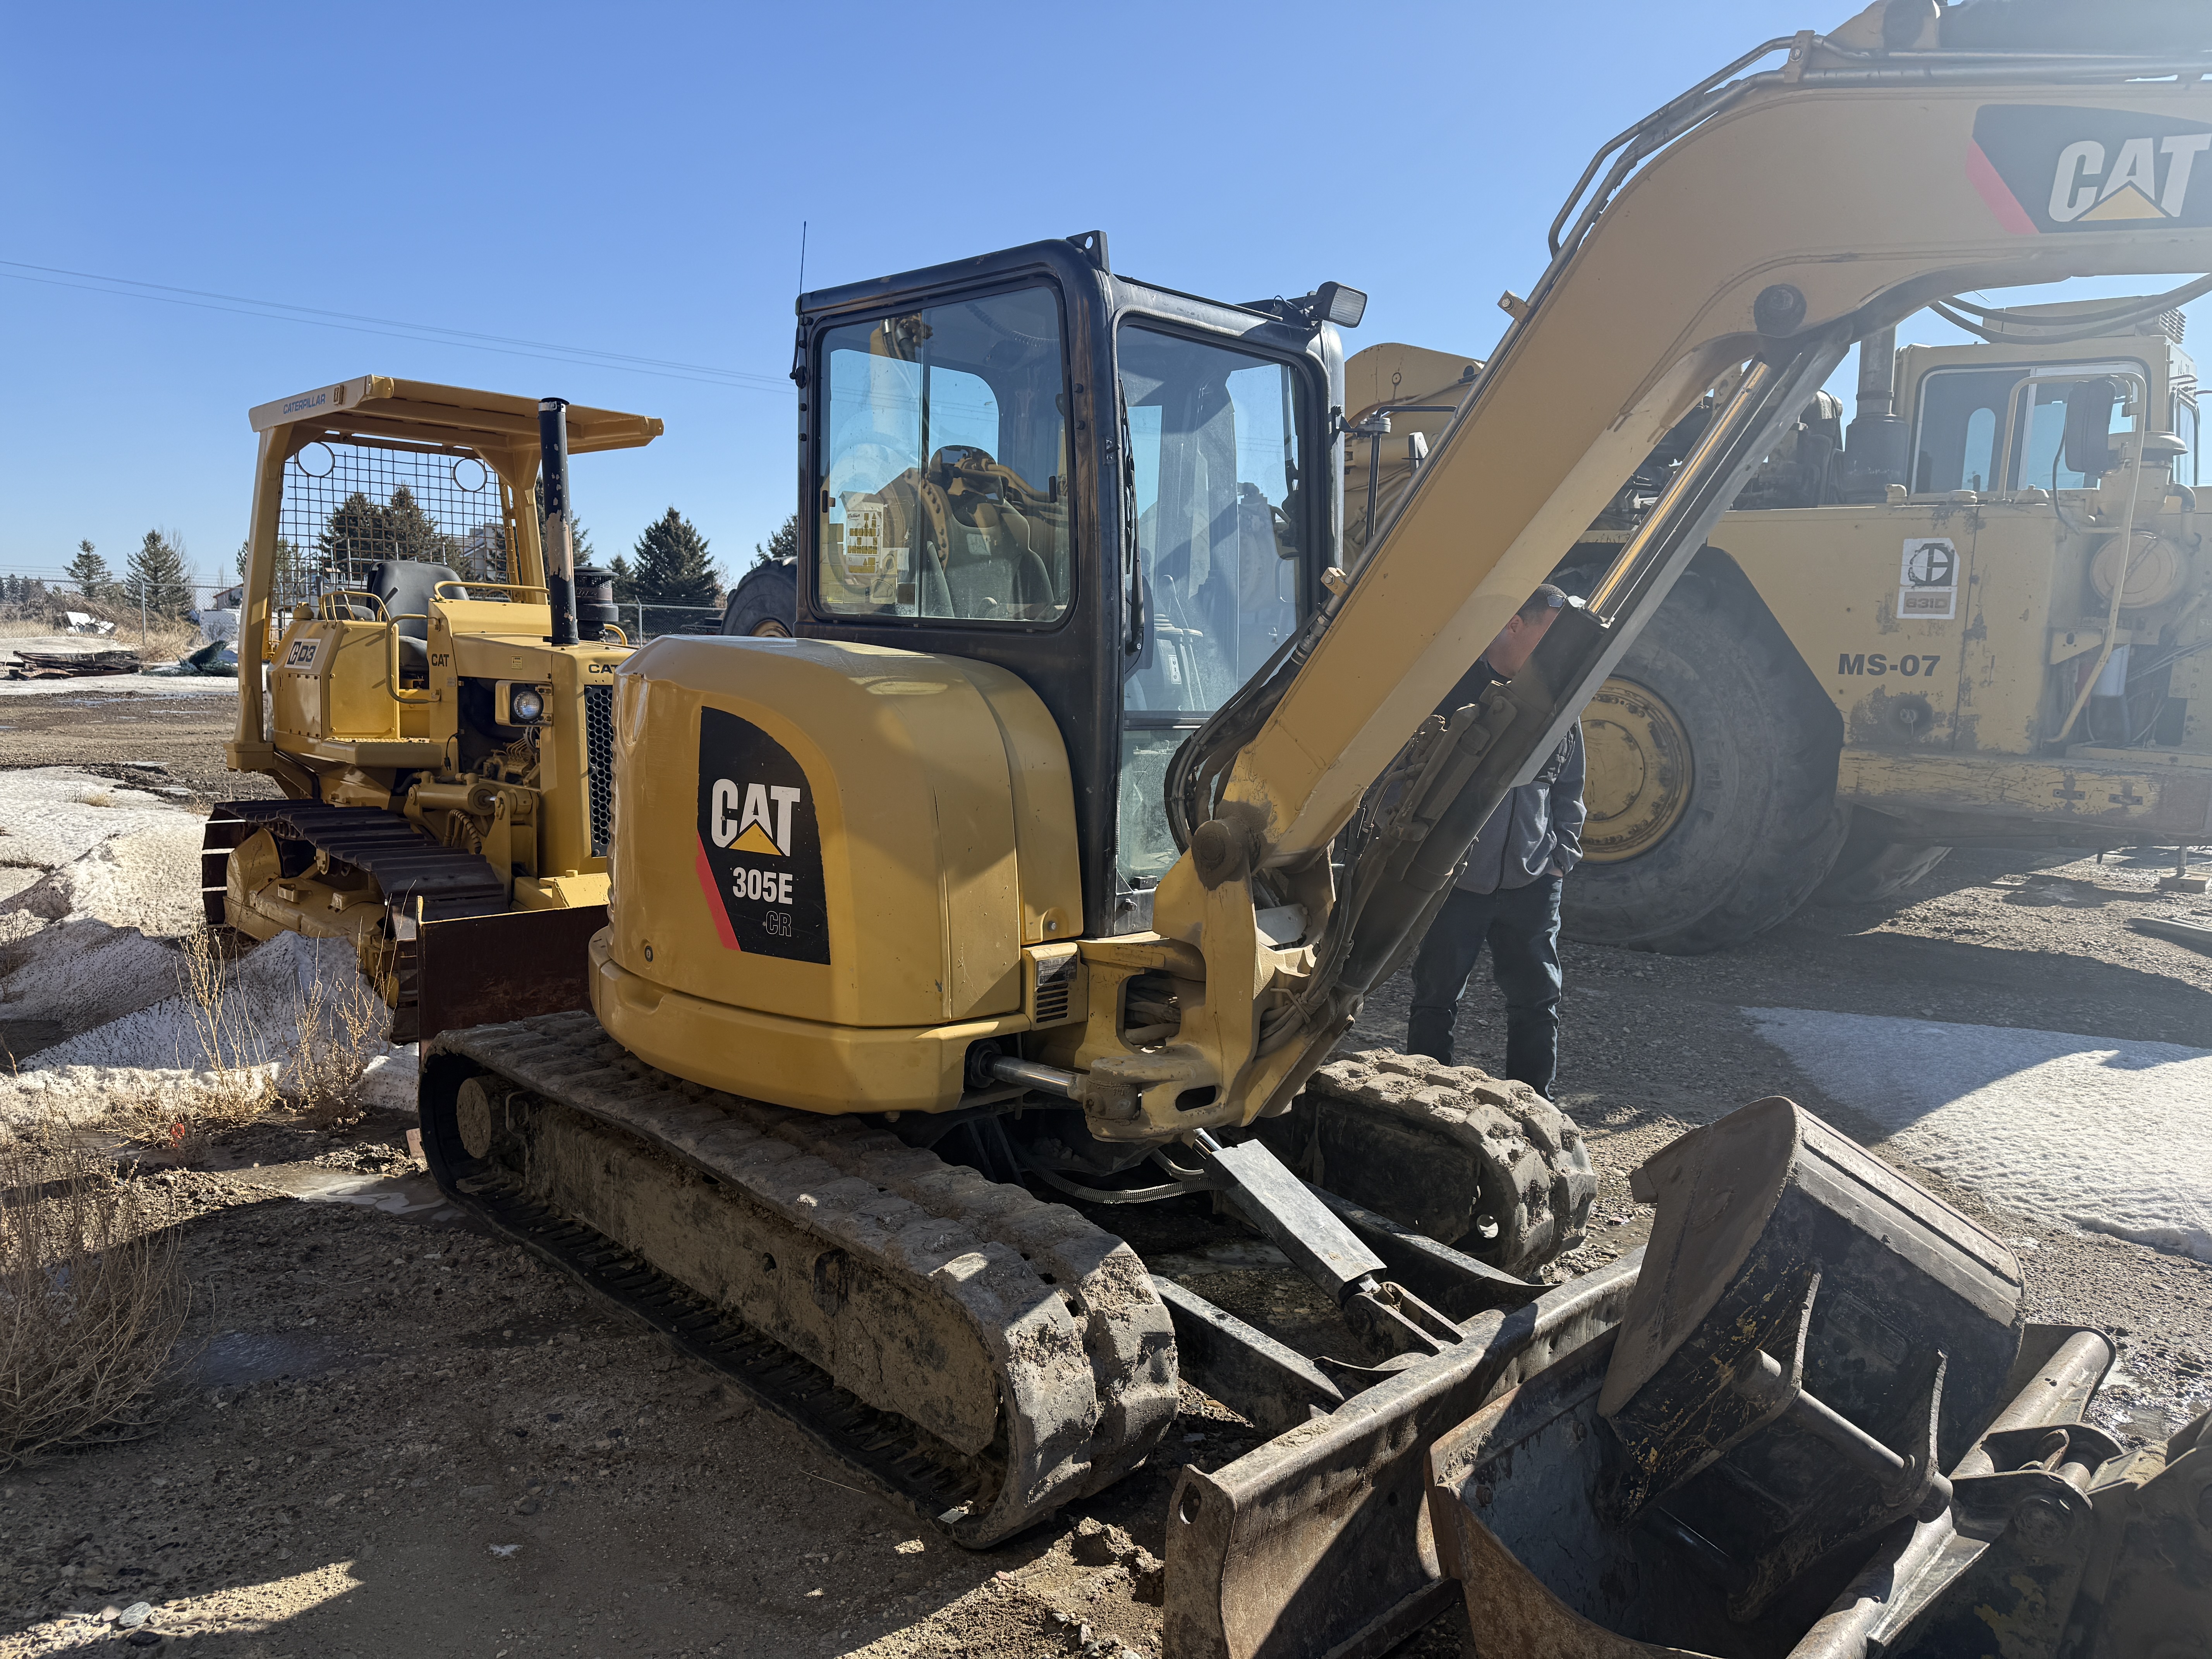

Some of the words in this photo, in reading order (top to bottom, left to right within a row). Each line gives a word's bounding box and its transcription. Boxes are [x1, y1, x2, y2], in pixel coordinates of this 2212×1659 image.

[2049, 133, 2212, 222] CAT
[283, 393, 325, 414] CATERPILLAR
[297, 646, 316, 662] D3
[431, 654, 449, 667] CAT
[1838, 653, 1940, 676] MS-07
[711, 778, 800, 857] CAT
[733, 867, 793, 905] 305E
[766, 911, 792, 937] CR
